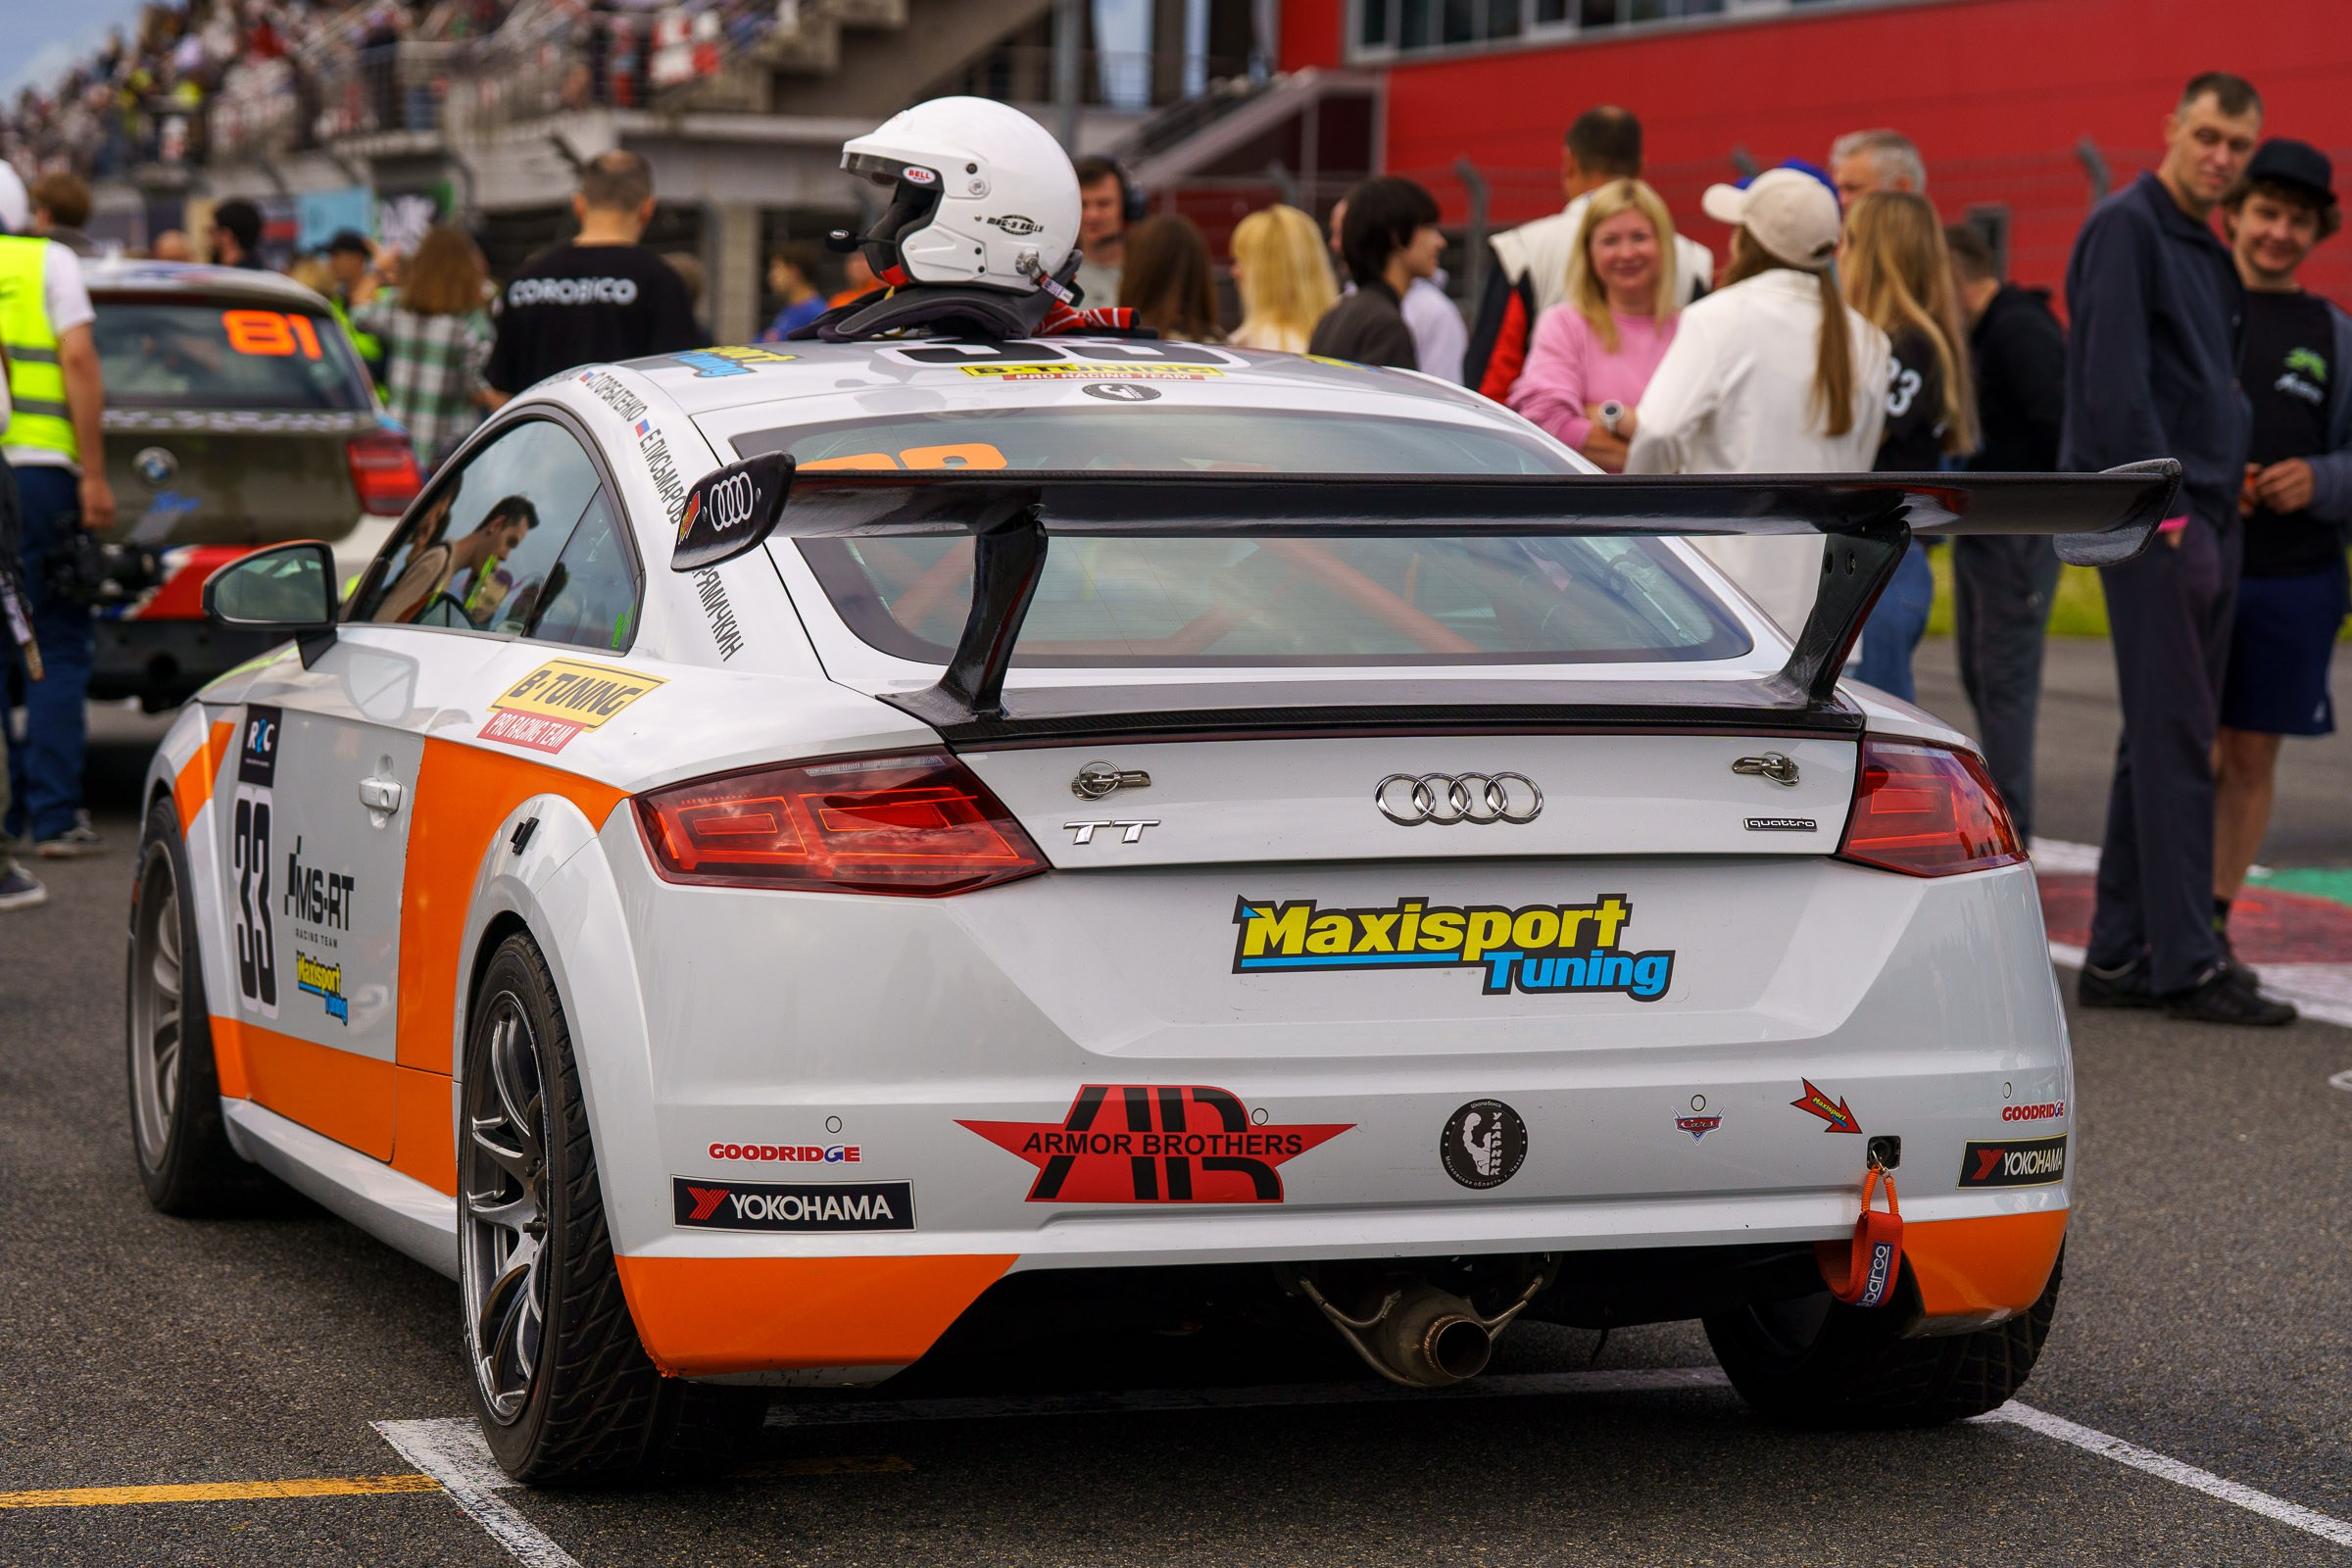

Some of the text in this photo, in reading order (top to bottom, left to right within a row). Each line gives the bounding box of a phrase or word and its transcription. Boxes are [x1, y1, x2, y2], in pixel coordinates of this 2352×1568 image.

[908, 169, 930, 179] BELL
[221, 310, 322, 361] 81
[486, 712, 576, 749] PRO RACING TEAM
[1063, 819, 1161, 845] TT
[1749, 819, 1814, 828] quattro
[234, 798, 276, 1007] 33
[296, 927, 338, 949] RACING TEAM
[1242, 899, 1627, 961] Maxisport
[1483, 950, 1669, 996] Tuning
[1813, 1097, 1847, 1121] Maxisport
[2002, 1101, 2064, 1121] GOODRIDGE
[1681, 1119, 1714, 1128] Cars
[709, 1143, 860, 1163] GOODRIDGE
[1022, 1133, 1302, 1155] ARMOR BROTHERS
[1490, 1112, 1502, 1175] УДАРНИК
[1446, 1155, 1473, 1185] Московская
[1510, 1153, 1524, 1173] Чехов
[2004, 1147, 2063, 1176] YOKOHAMA
[730, 1194, 894, 1221] YOKOHAMA
